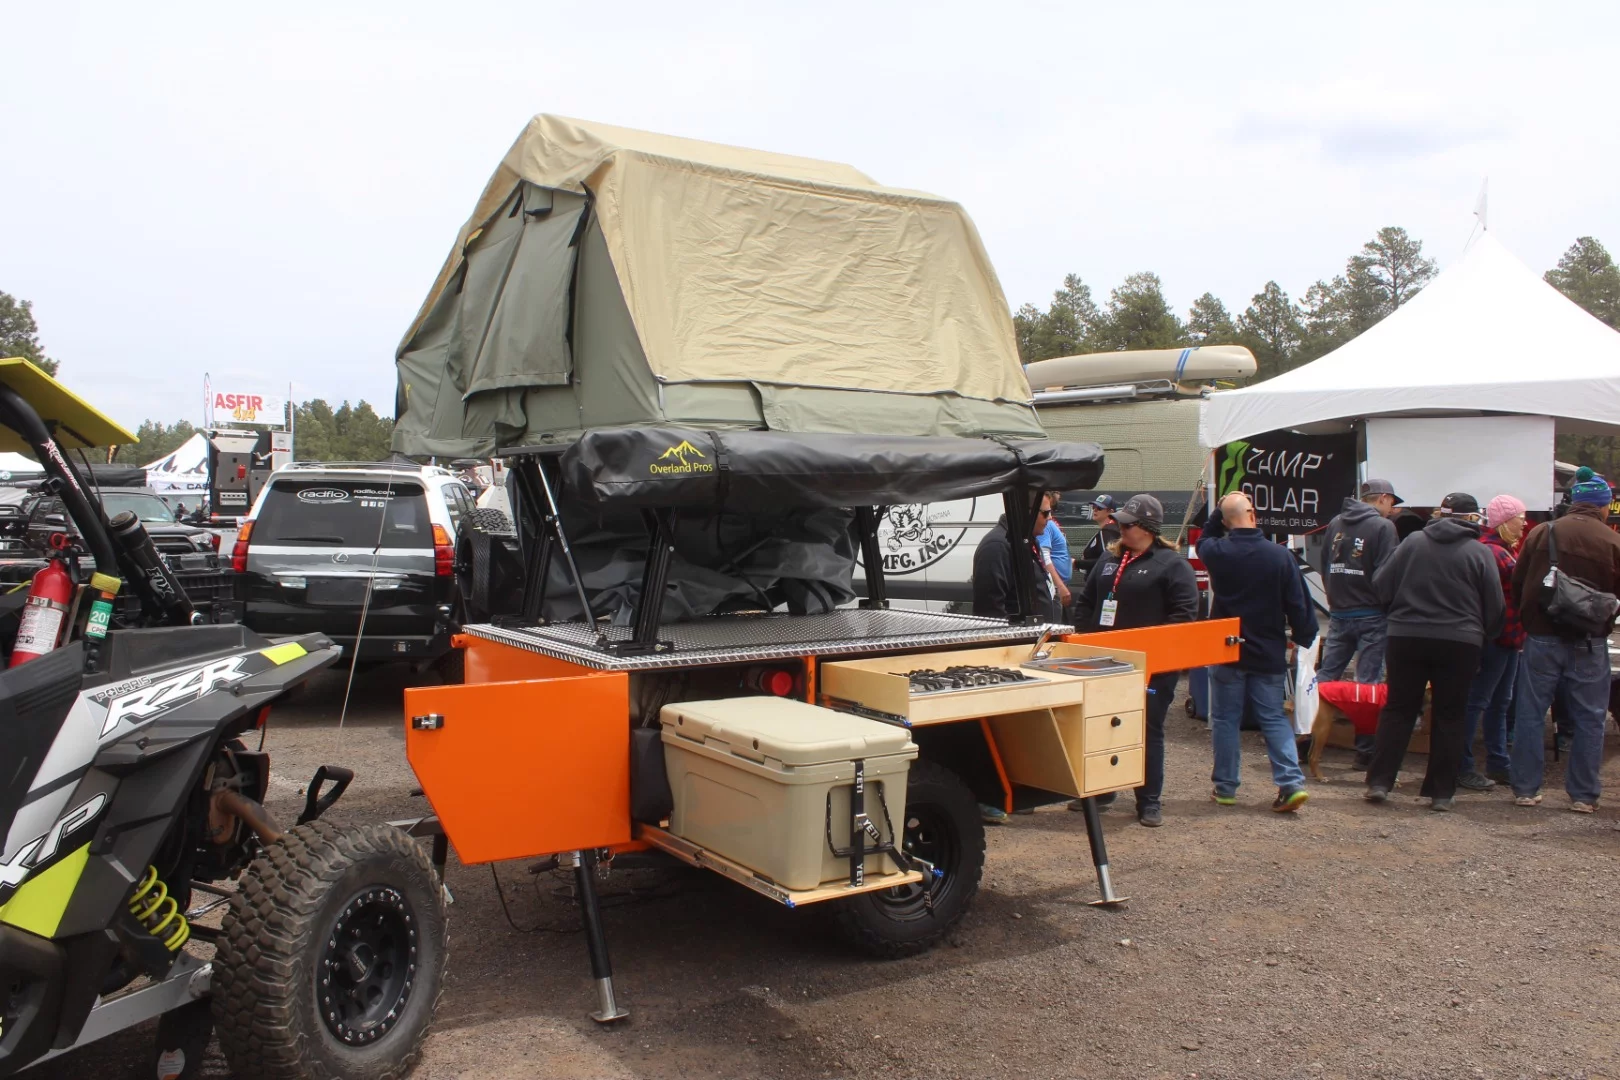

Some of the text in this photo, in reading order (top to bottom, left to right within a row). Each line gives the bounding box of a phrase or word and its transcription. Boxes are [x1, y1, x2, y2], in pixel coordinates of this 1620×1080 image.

[215, 393, 263, 411] ASFIR
[650, 462, 713, 474] Overland Pros
[1246, 447, 1324, 478] ZAMP
[1241, 482, 1319, 514] SOLAR
[1302, 518, 1319, 527] USA
[918, 534, 953, 563] INC.
[96, 676, 153, 702] POLARIS
[99, 655, 253, 741] RZR
[863, 818, 880, 840] YETI
[923, 890, 933, 908] YETI
